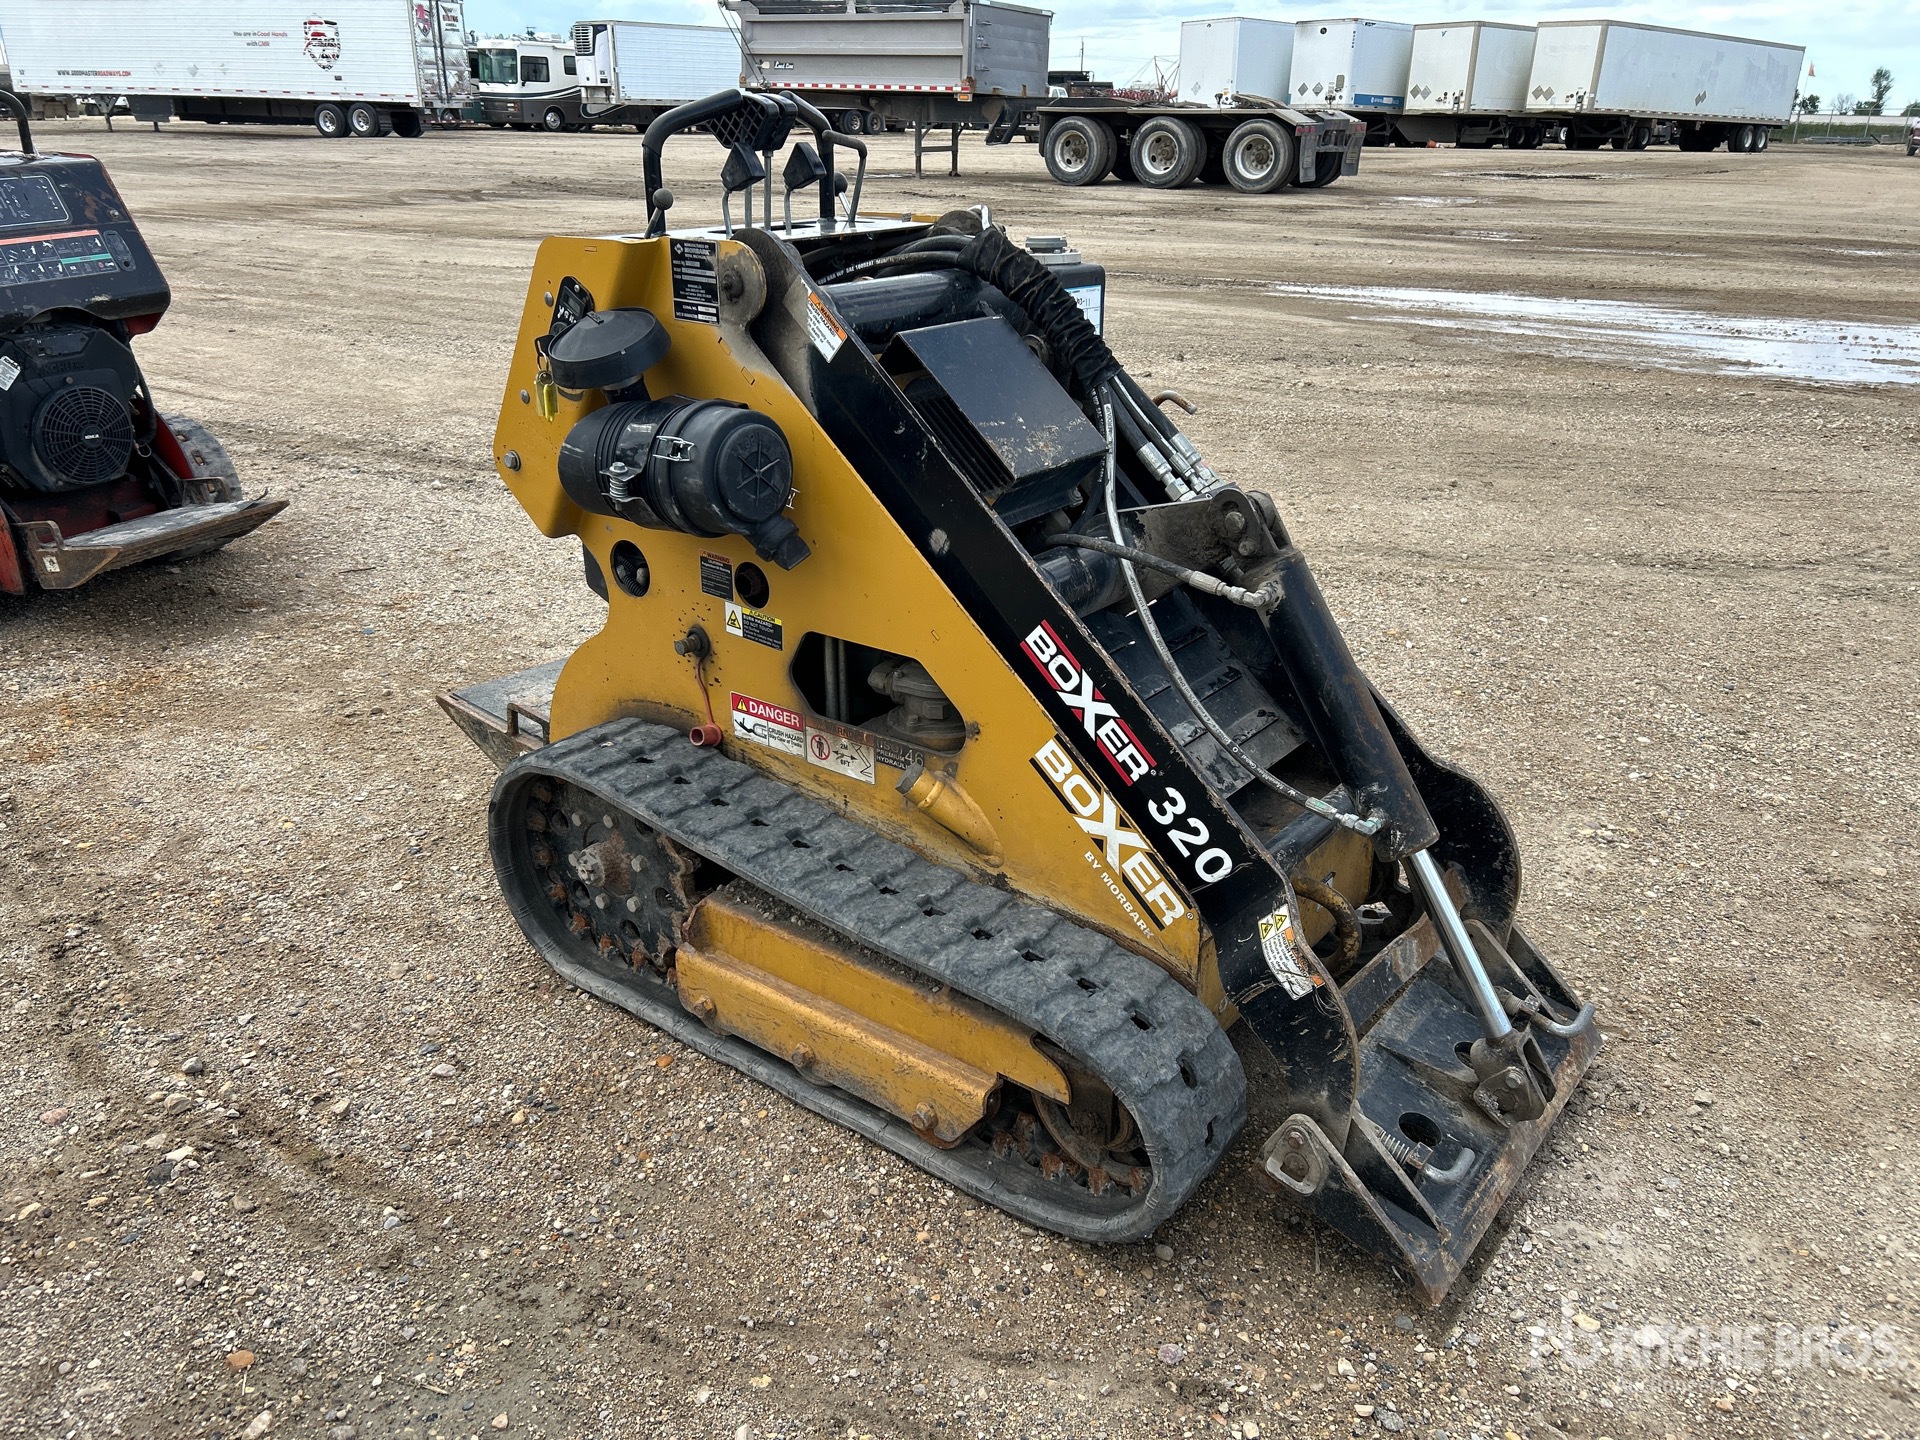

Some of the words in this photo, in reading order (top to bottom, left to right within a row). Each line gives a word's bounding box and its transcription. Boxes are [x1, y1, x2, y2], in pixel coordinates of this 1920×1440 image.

[820, 306, 840, 332] WARNING
[707, 552, 729, 563] WARNING
[754, 612, 775, 622] CAUTION
[1025, 624, 1150, 782] BOXER
[749, 700, 800, 728] DANGER
[768, 727, 785, 736] CRUSH
[784, 732, 804, 743] HAZARD
[840, 743, 849, 751] 2M
[876, 748, 905, 761] PREMIUM
[876, 755, 911, 770] HYDRAULI
[905, 749, 924, 767] 46
[1035, 738, 1185, 927] BOXER
[1148, 787, 1233, 883] 320
[1084, 850, 1101, 870] BY
[1101, 872, 1155, 939] MORBARK
[1281, 932, 1290, 953] CRUSH
